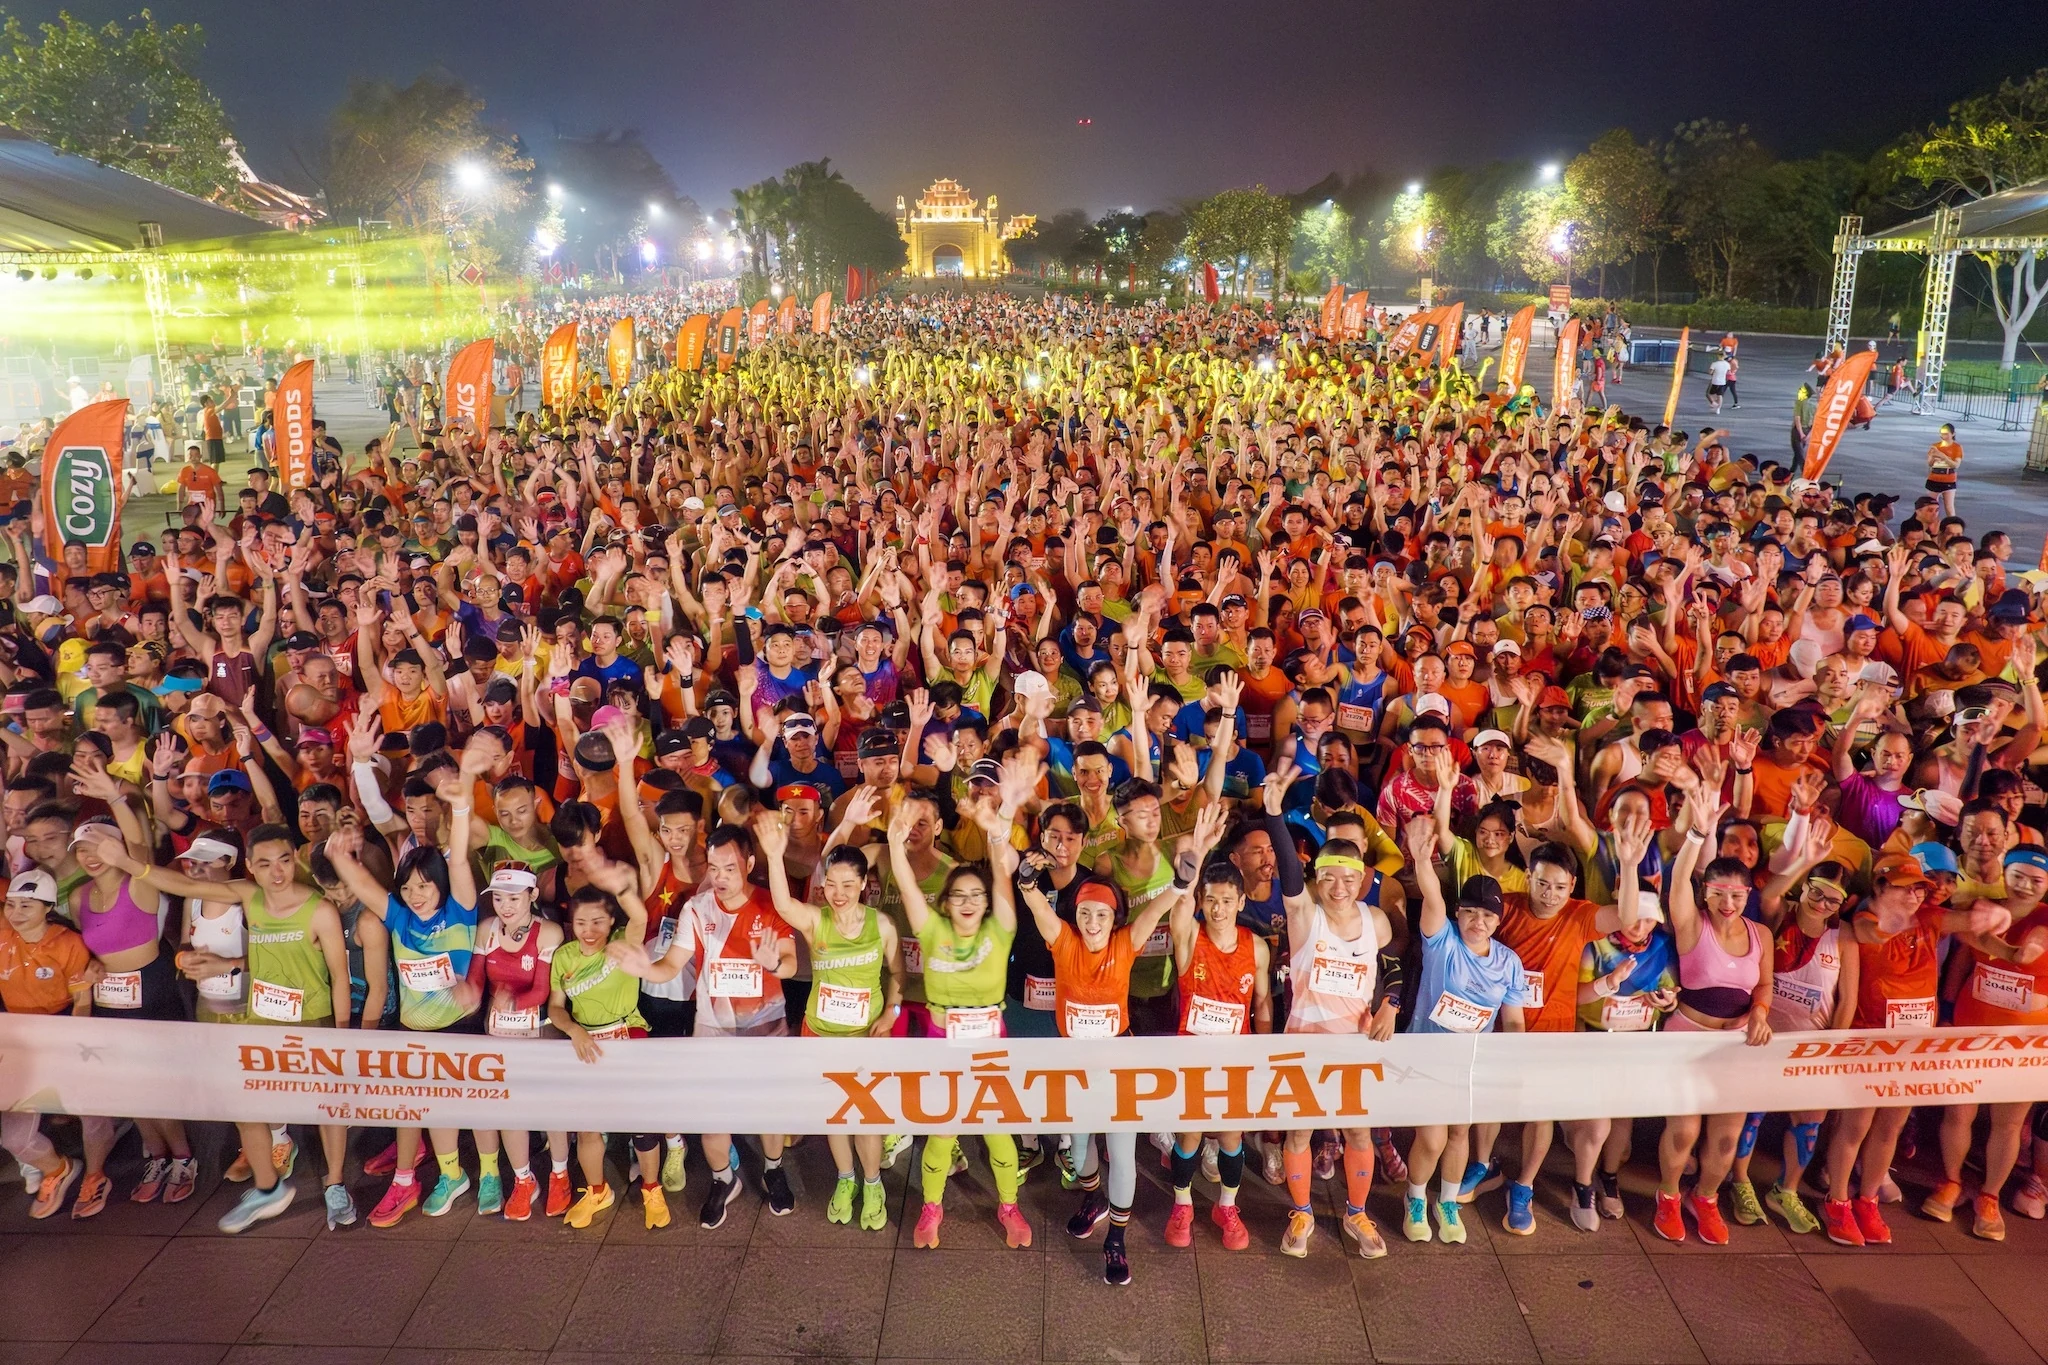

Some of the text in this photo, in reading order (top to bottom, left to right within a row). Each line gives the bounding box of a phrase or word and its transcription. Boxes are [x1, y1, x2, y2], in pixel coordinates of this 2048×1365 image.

[286, 389, 307, 490] AFOODS
[66, 458, 103, 536] Cozy
[721, 972, 750, 981] 21043
[1324, 969, 1355, 981] 21543
[100, 983, 130, 994] 20965
[263, 995, 288, 1007] 21417
[830, 999, 858, 1010] 21527
[498, 1013, 528, 1023] 20077
[1201, 1012, 1231, 1024] 22185
[1448, 1007, 1478, 1022] 20747
[1898, 1012, 1928, 1021] 20477
[238, 1034, 506, 1083] ĐỀN HÙNG
[1783, 1056, 2048, 1077] SPIRITUALITY MARATHON 202
[243, 1078, 510, 1100] SPIRITUALITY MARATHON 2024
[822, 1050, 1385, 1126] XUẤT PHÁT
